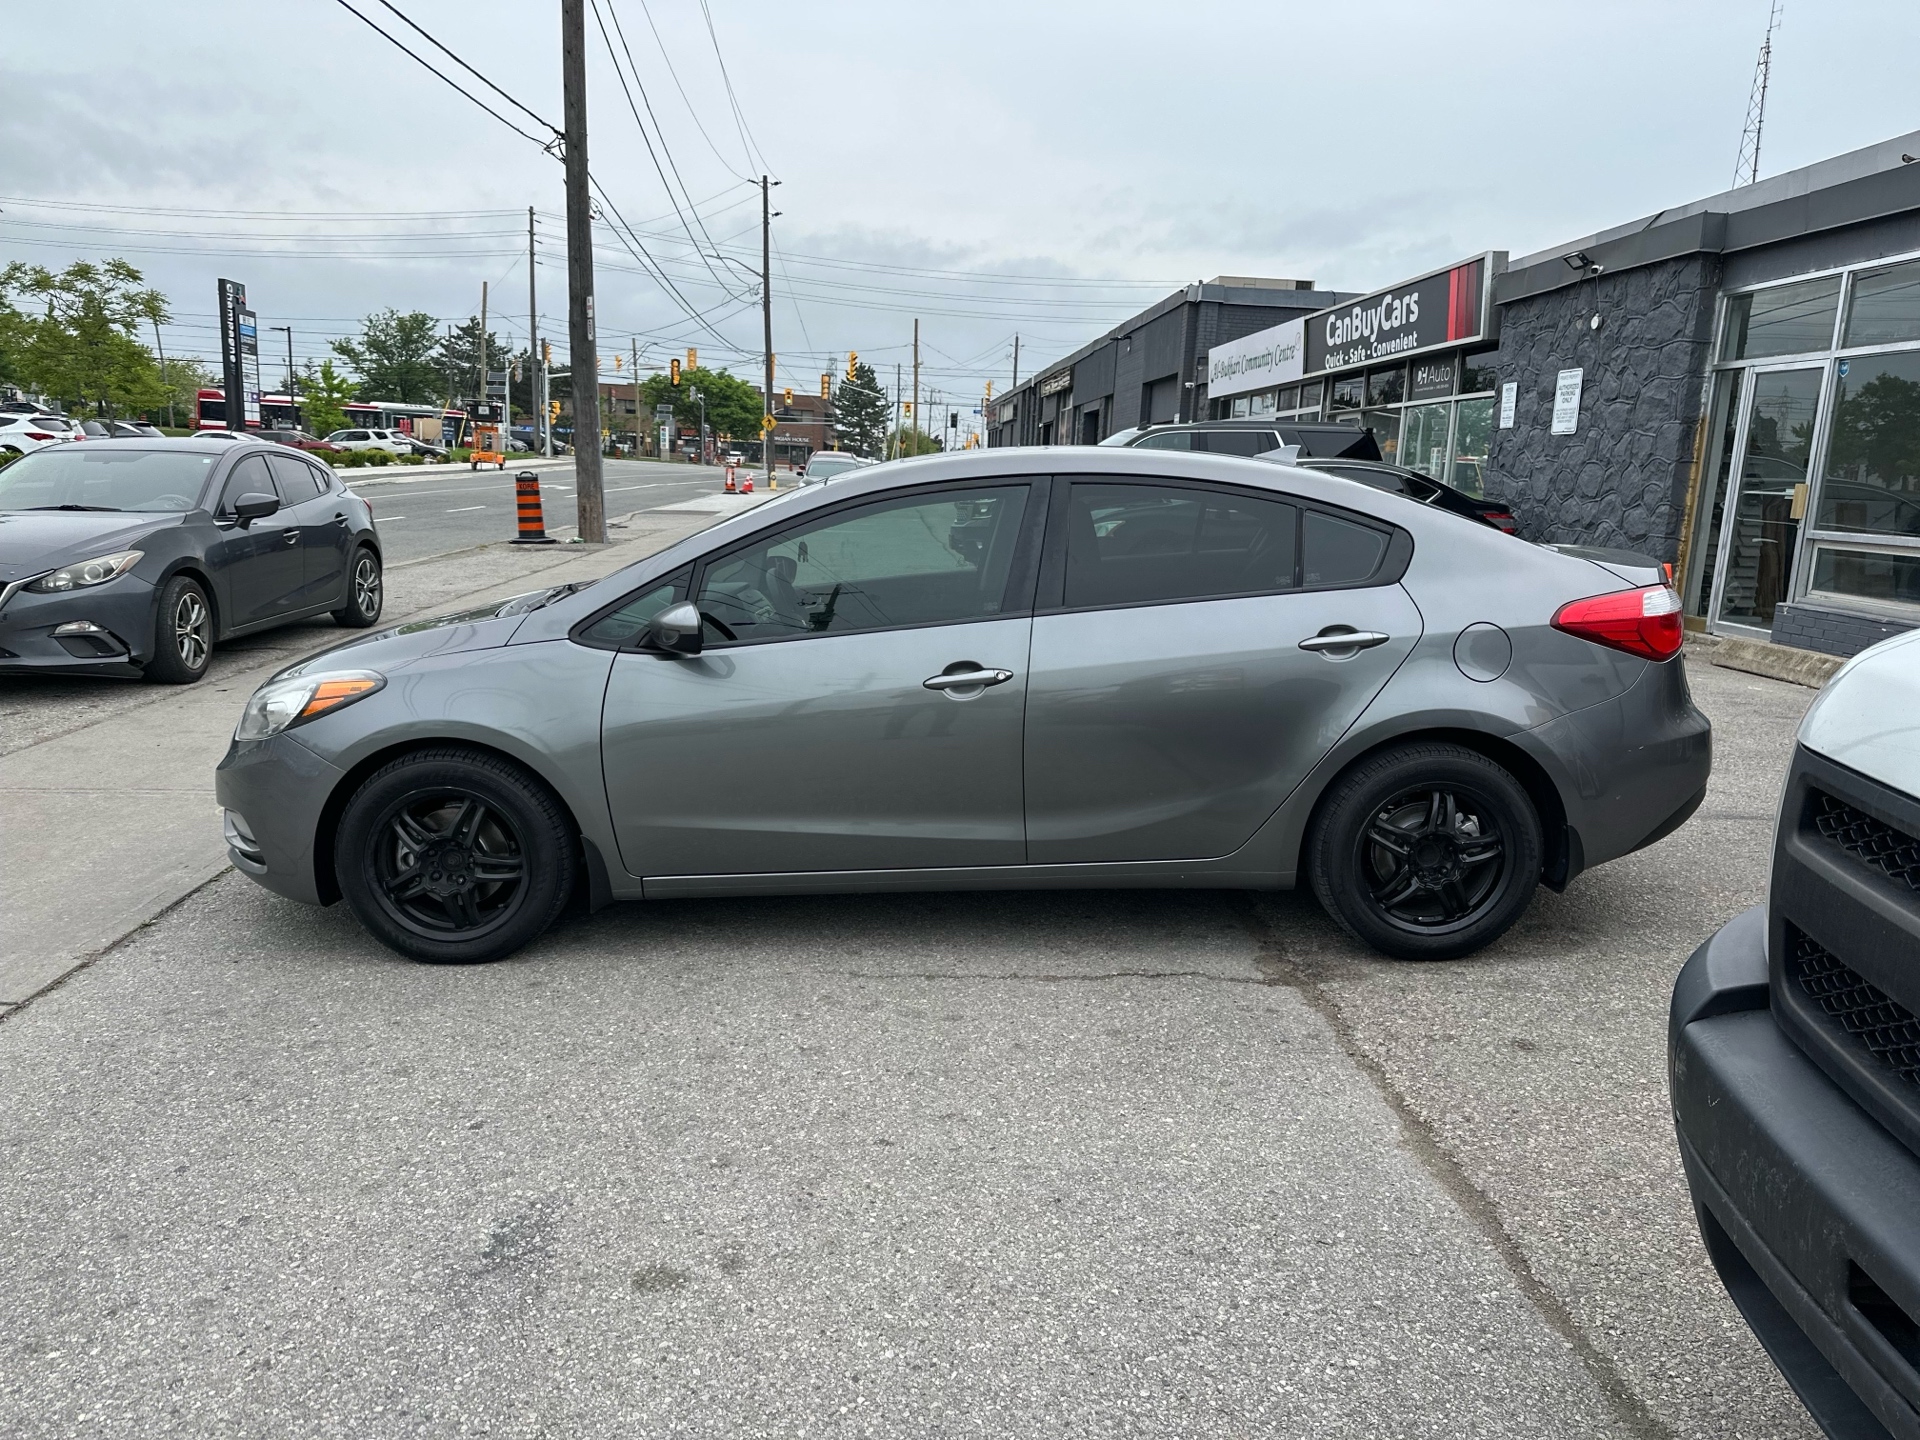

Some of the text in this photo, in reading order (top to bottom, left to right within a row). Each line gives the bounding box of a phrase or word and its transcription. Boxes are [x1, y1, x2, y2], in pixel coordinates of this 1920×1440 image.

[1326, 292, 1419, 347] CanBuyCars
[1241, 347, 1274, 373] Community
[1275, 344, 1296, 366] Centre
[1325, 350, 1345, 369] Quick
[1349, 345, 1366, 364] Safe
[1371, 330, 1418, 358] Convenient
[1429, 364, 1451, 383] Auto
